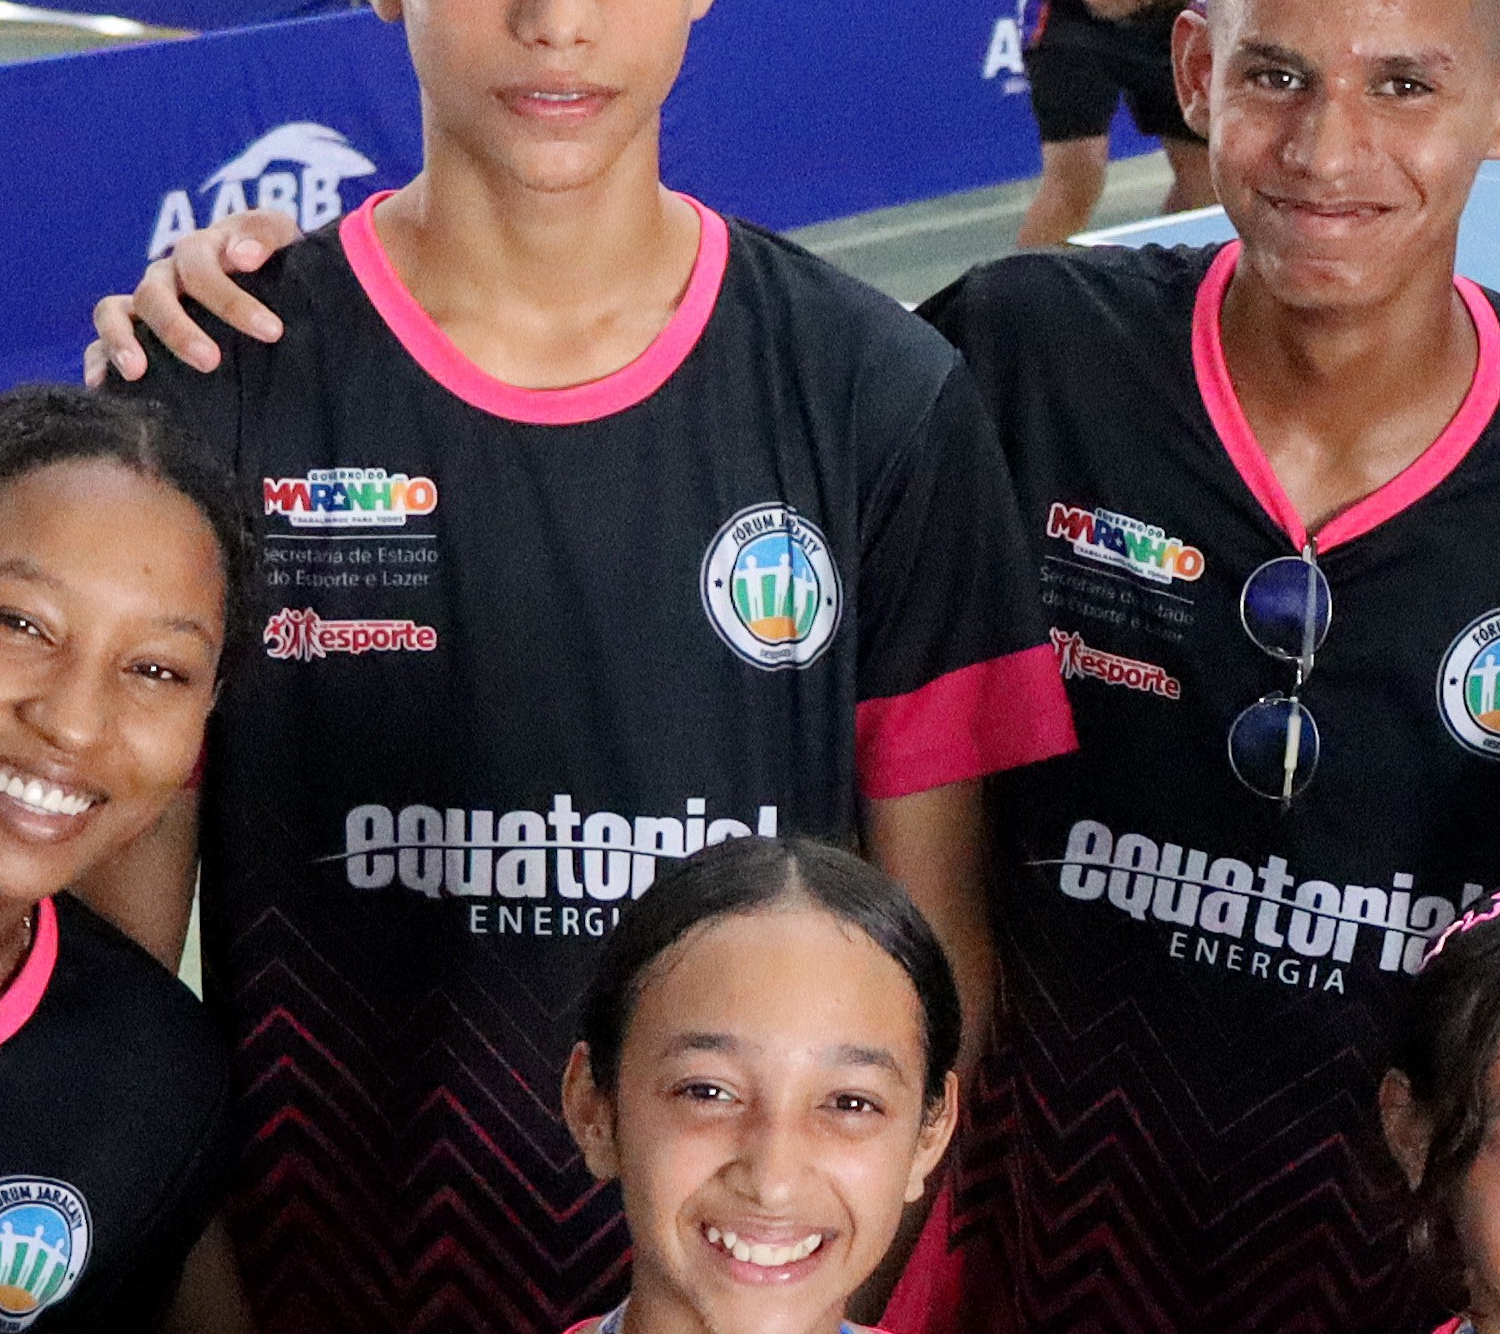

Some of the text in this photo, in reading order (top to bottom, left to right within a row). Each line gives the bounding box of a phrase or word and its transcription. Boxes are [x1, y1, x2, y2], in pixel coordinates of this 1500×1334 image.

[264, 476, 435, 512] MARANHÃO
[349, 547, 372, 564] de
[378, 546, 439, 564] Estado
[1050, 505, 1203, 577] MARANHÃO
[268, 569, 290, 586] do
[382, 569, 431, 587] Lazer
[318, 623, 436, 652] esporte
[1080, 653, 1181, 699] esporte
[1169, 931, 1346, 995] ENERGIA
